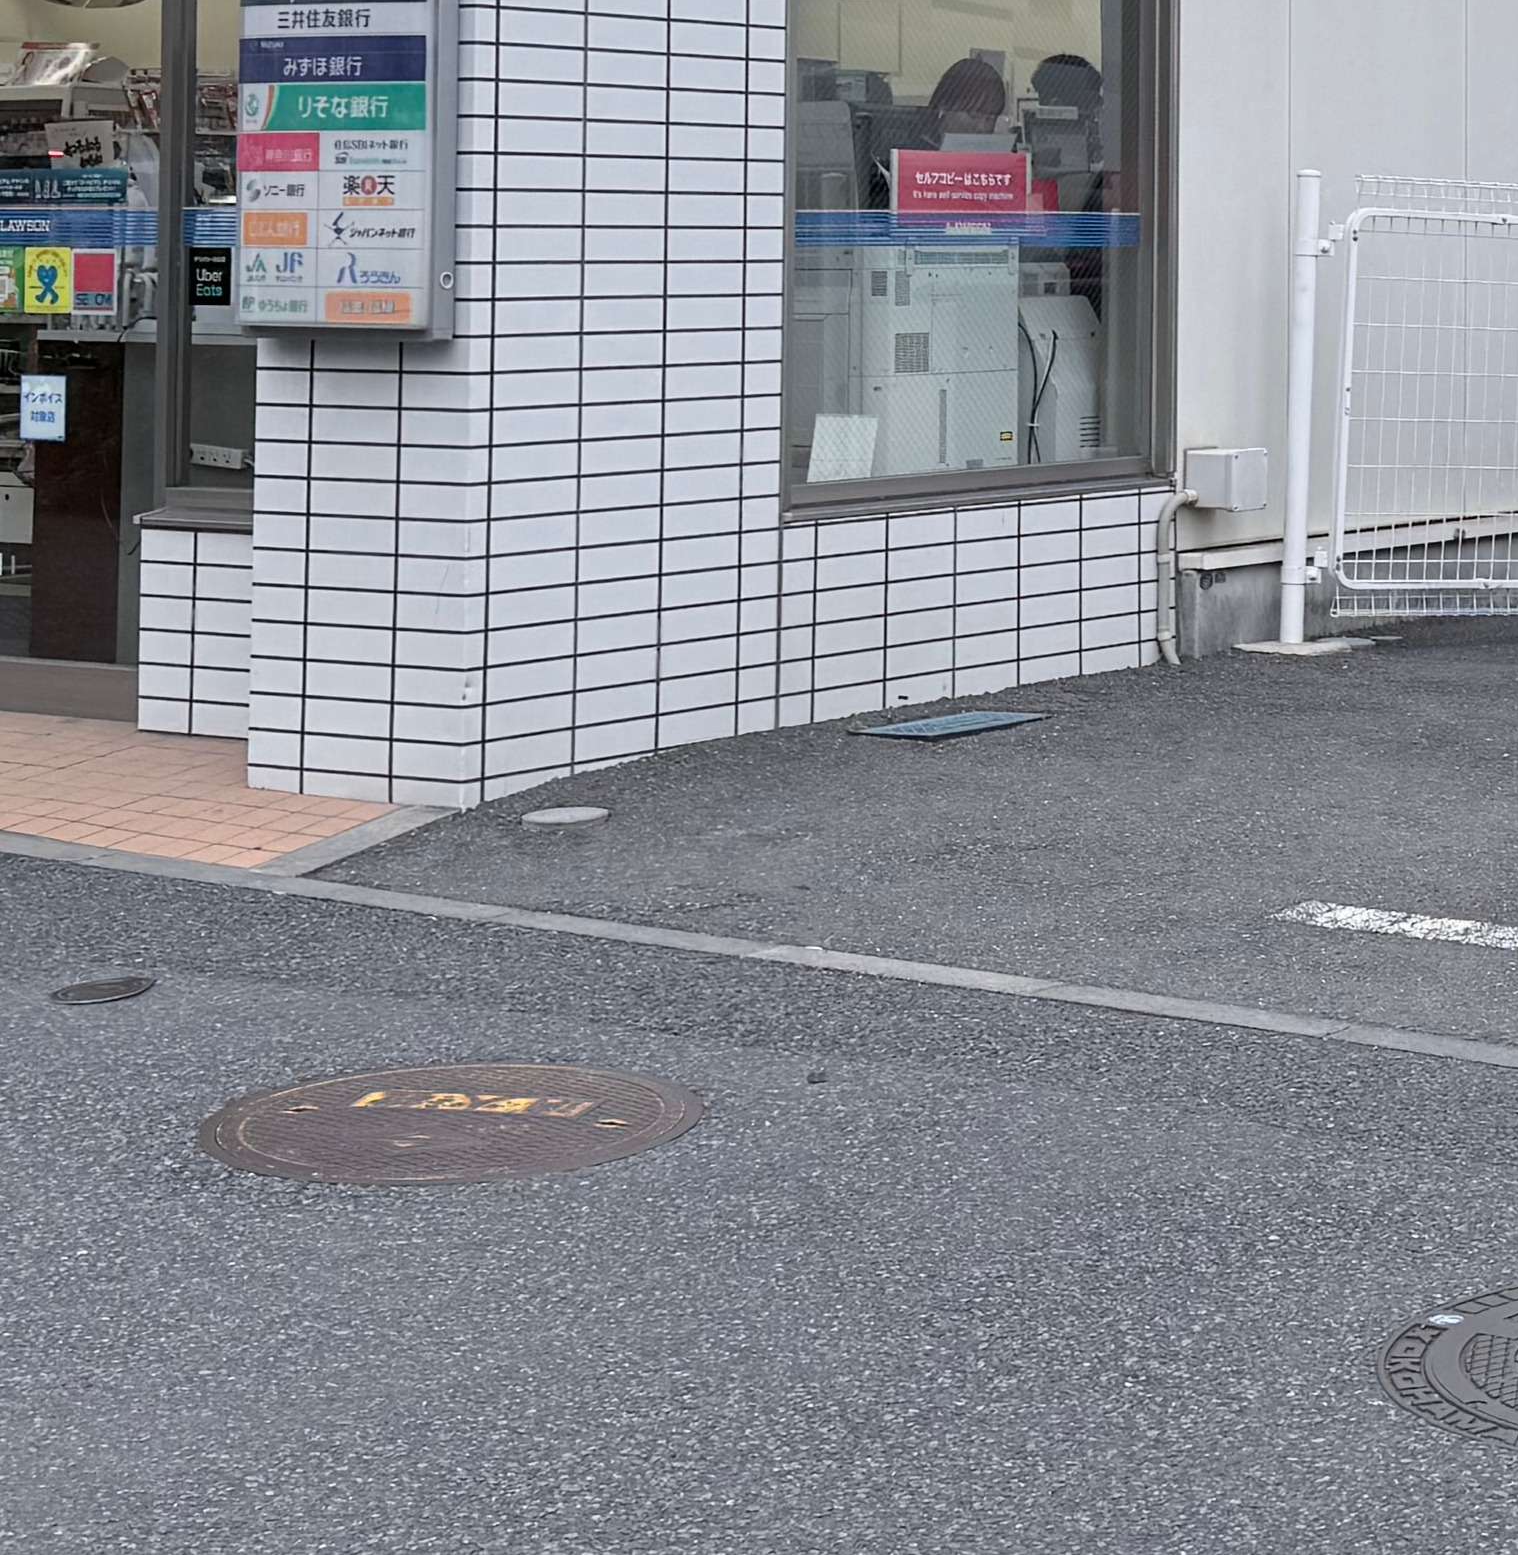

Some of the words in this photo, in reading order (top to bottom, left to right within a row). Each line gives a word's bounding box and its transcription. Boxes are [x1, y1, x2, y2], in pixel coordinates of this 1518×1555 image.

[277, 9, 371, 29] 三井住友銀行
[283, 57, 362, 77] みずほ銀行
[299, 96, 388, 119] りそな銀行
[915, 171, 1012, 186] セルフコピーはこちらです
[264, 184, 305, 197] ソニー銀行
[349, 227, 415, 239] ジャパンネット銀行
[196, 268, 222, 282] Uber
[360, 270, 401, 284] ろうきん
[196, 283, 222, 296] Eats
[258, 299, 308, 313] ゆうちょ銀行
[24, 392, 63, 403] インボイス
